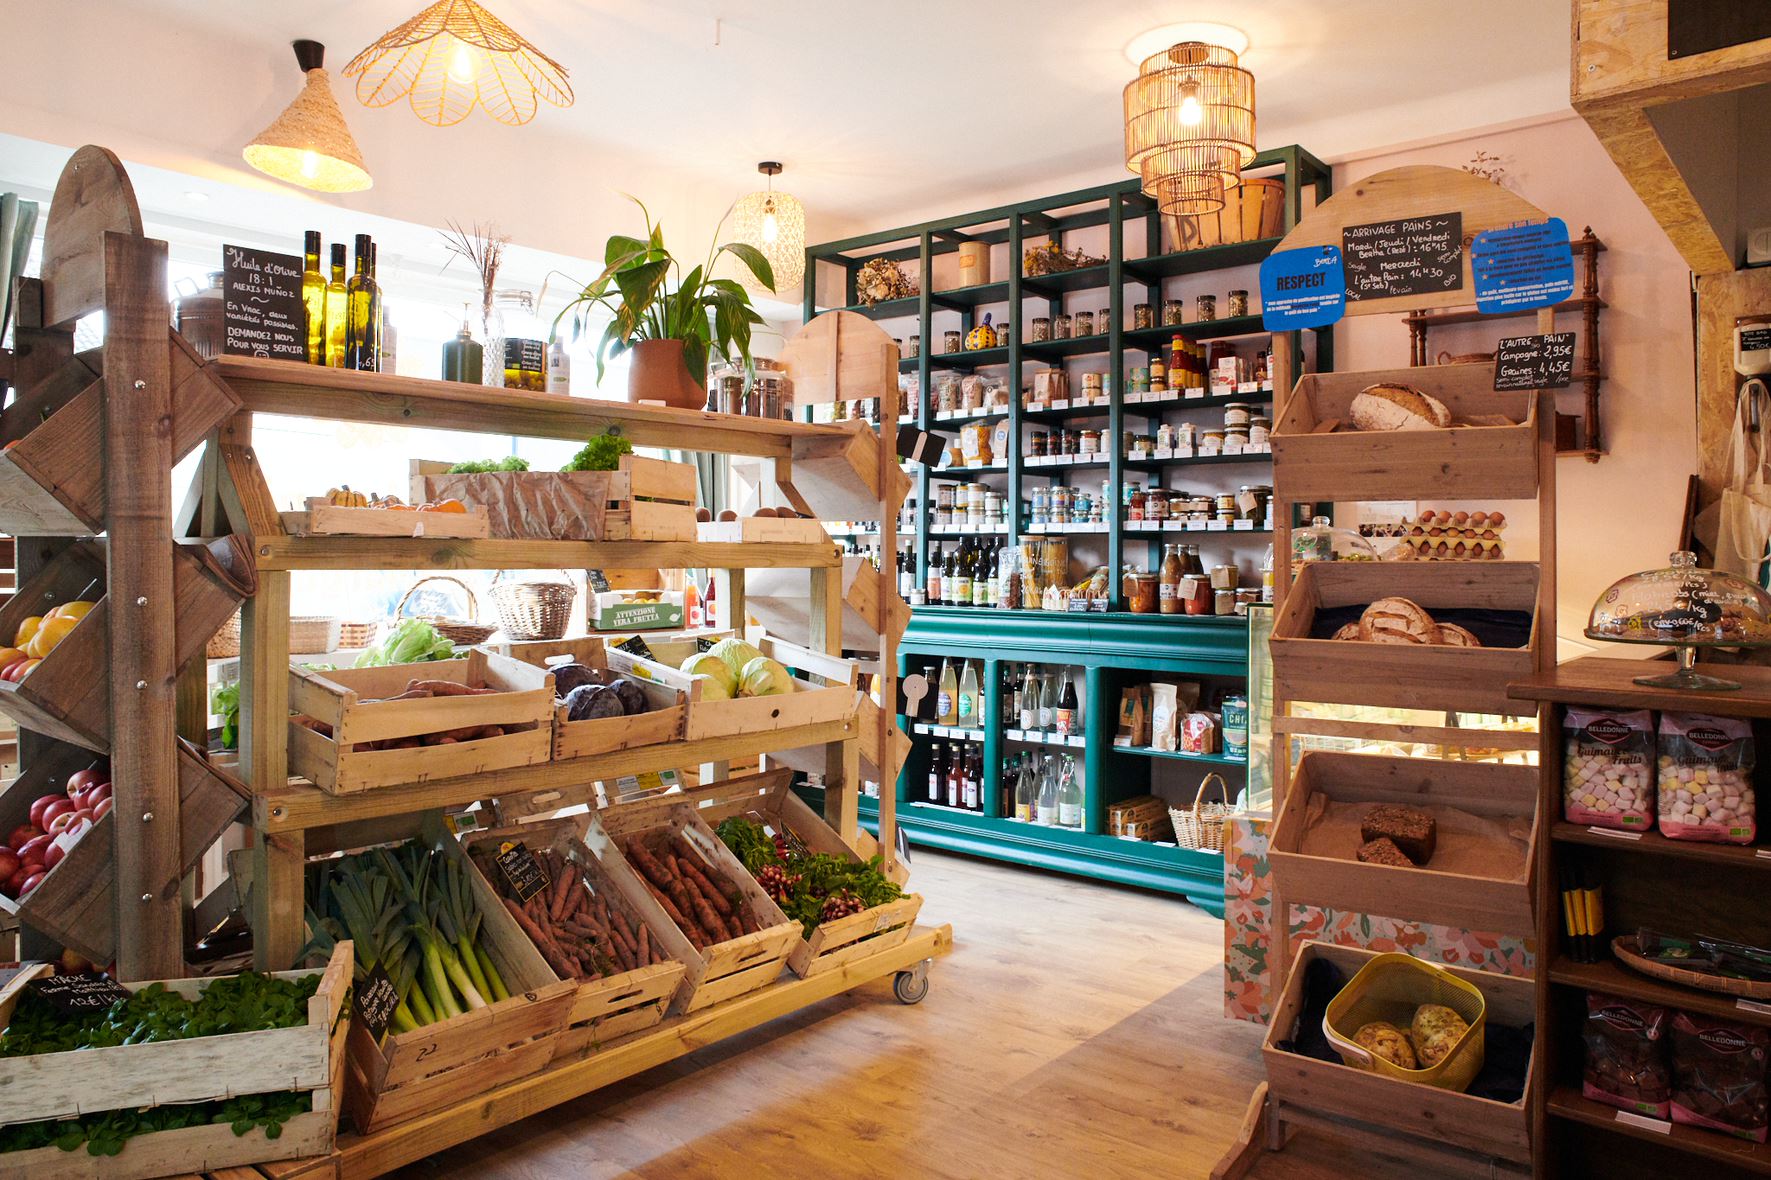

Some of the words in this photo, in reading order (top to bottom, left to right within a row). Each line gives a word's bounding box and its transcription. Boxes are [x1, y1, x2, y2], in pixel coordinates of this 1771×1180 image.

[1277, 272, 1326, 291] RESPECT
[227, 327, 271, 341] DEMANDEZ
[1544, 345, 1572, 359] 2,95€
[1540, 361, 1570, 376] 4,45€
[616, 606, 656, 618] ATTENZIONE
[613, 618, 630, 626] VERA
[633, 613, 660, 624] FRUTTA
[1230, 714, 1246, 724] CHI
[1588, 725, 1629, 734] BELLEDONNE
[1700, 1034, 1746, 1048] BELLEDONNE
